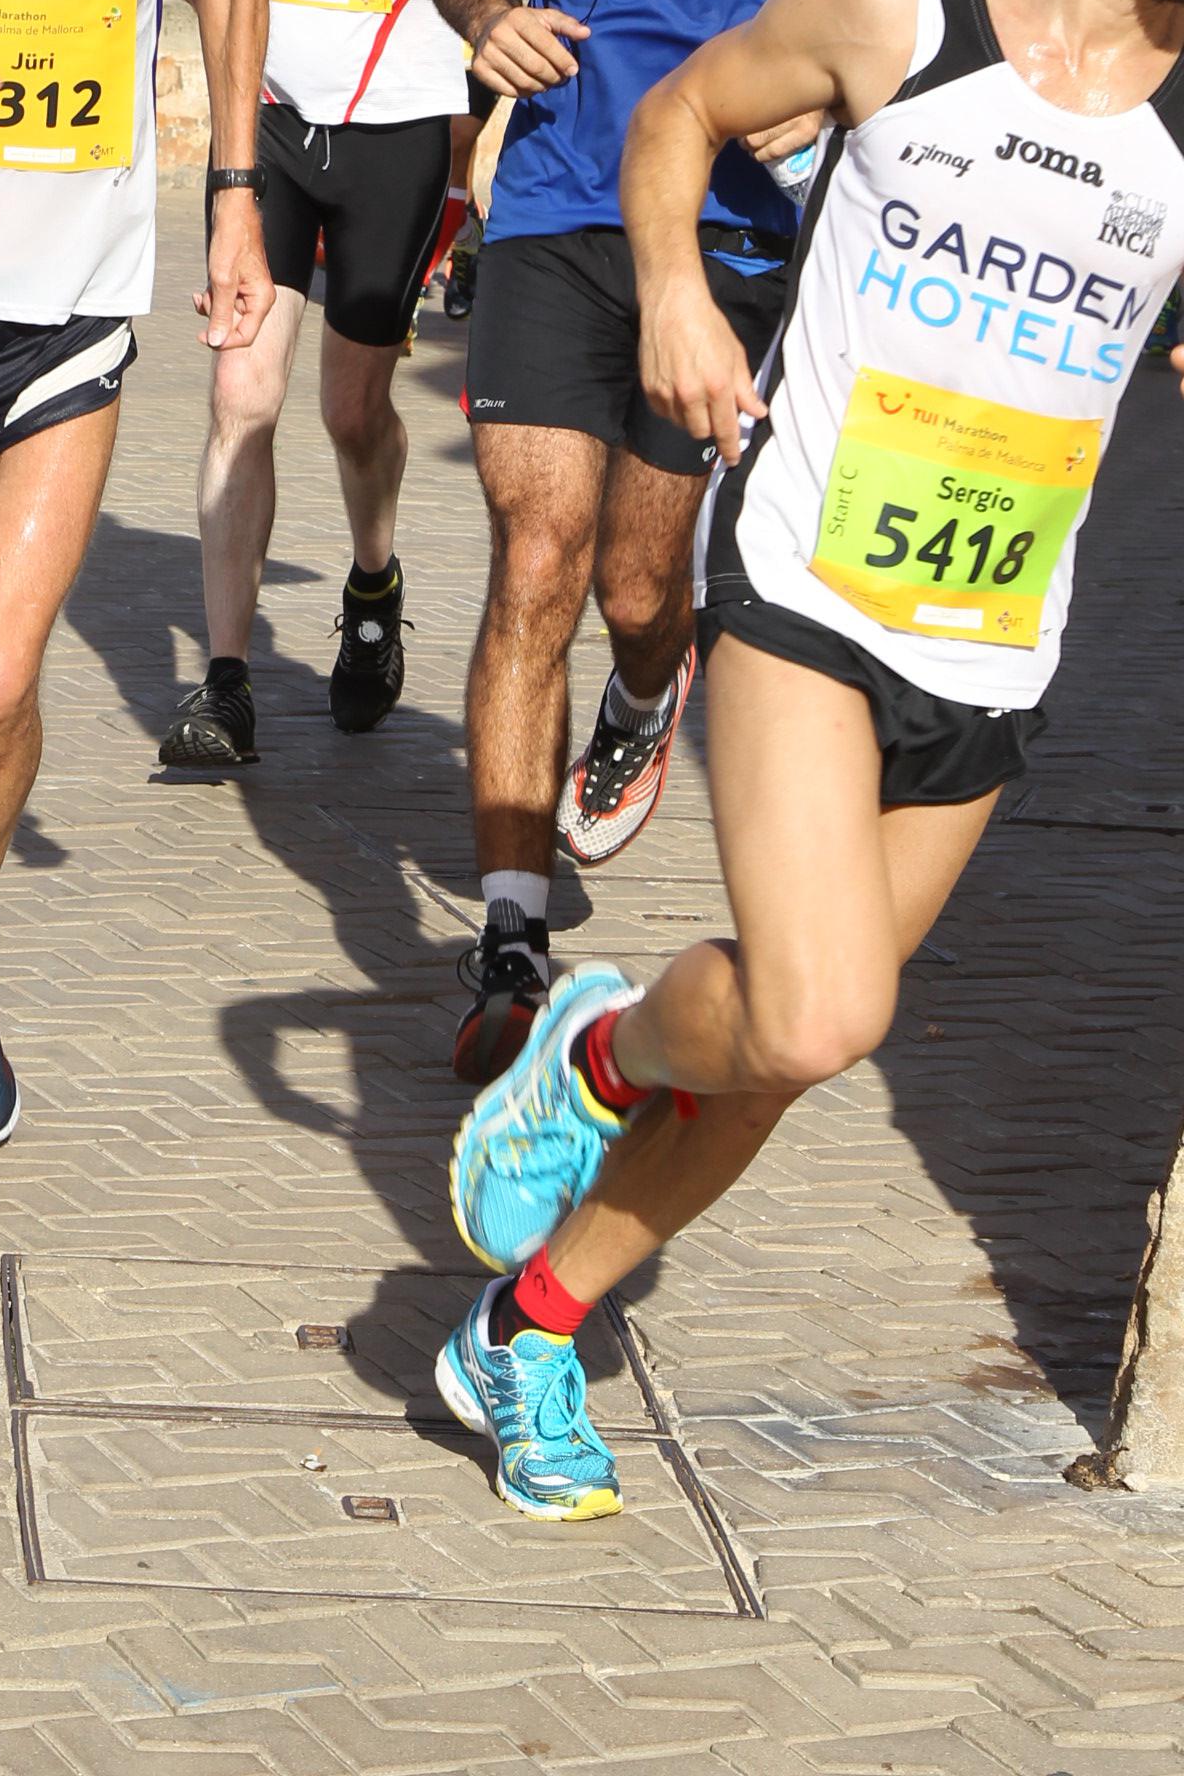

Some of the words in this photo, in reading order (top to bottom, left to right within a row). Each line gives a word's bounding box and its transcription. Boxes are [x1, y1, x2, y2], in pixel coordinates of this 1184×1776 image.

[25, 26, 39, 35] de
[42, 25, 84, 35] Mallorca
[11, 52, 55, 70] Jüri
[995, 132, 1105, 188] Joma
[1097, 223, 1155, 258] INCA
[881, 199, 1154, 331] GARDEN
[857, 249, 1127, 384] HOTELS
[913, 408, 939, 425] TUI
[943, 417, 1008, 443] Marathon
[937, 436, 975, 457] Palma
[977, 448, 993, 460] de
[996, 449, 1046, 472] Mallorca
[839, 465, 858, 480] C
[827, 488, 854, 536] Start
[936, 477, 1015, 513] Sergio
[865, 502, 1035, 585] 5418
